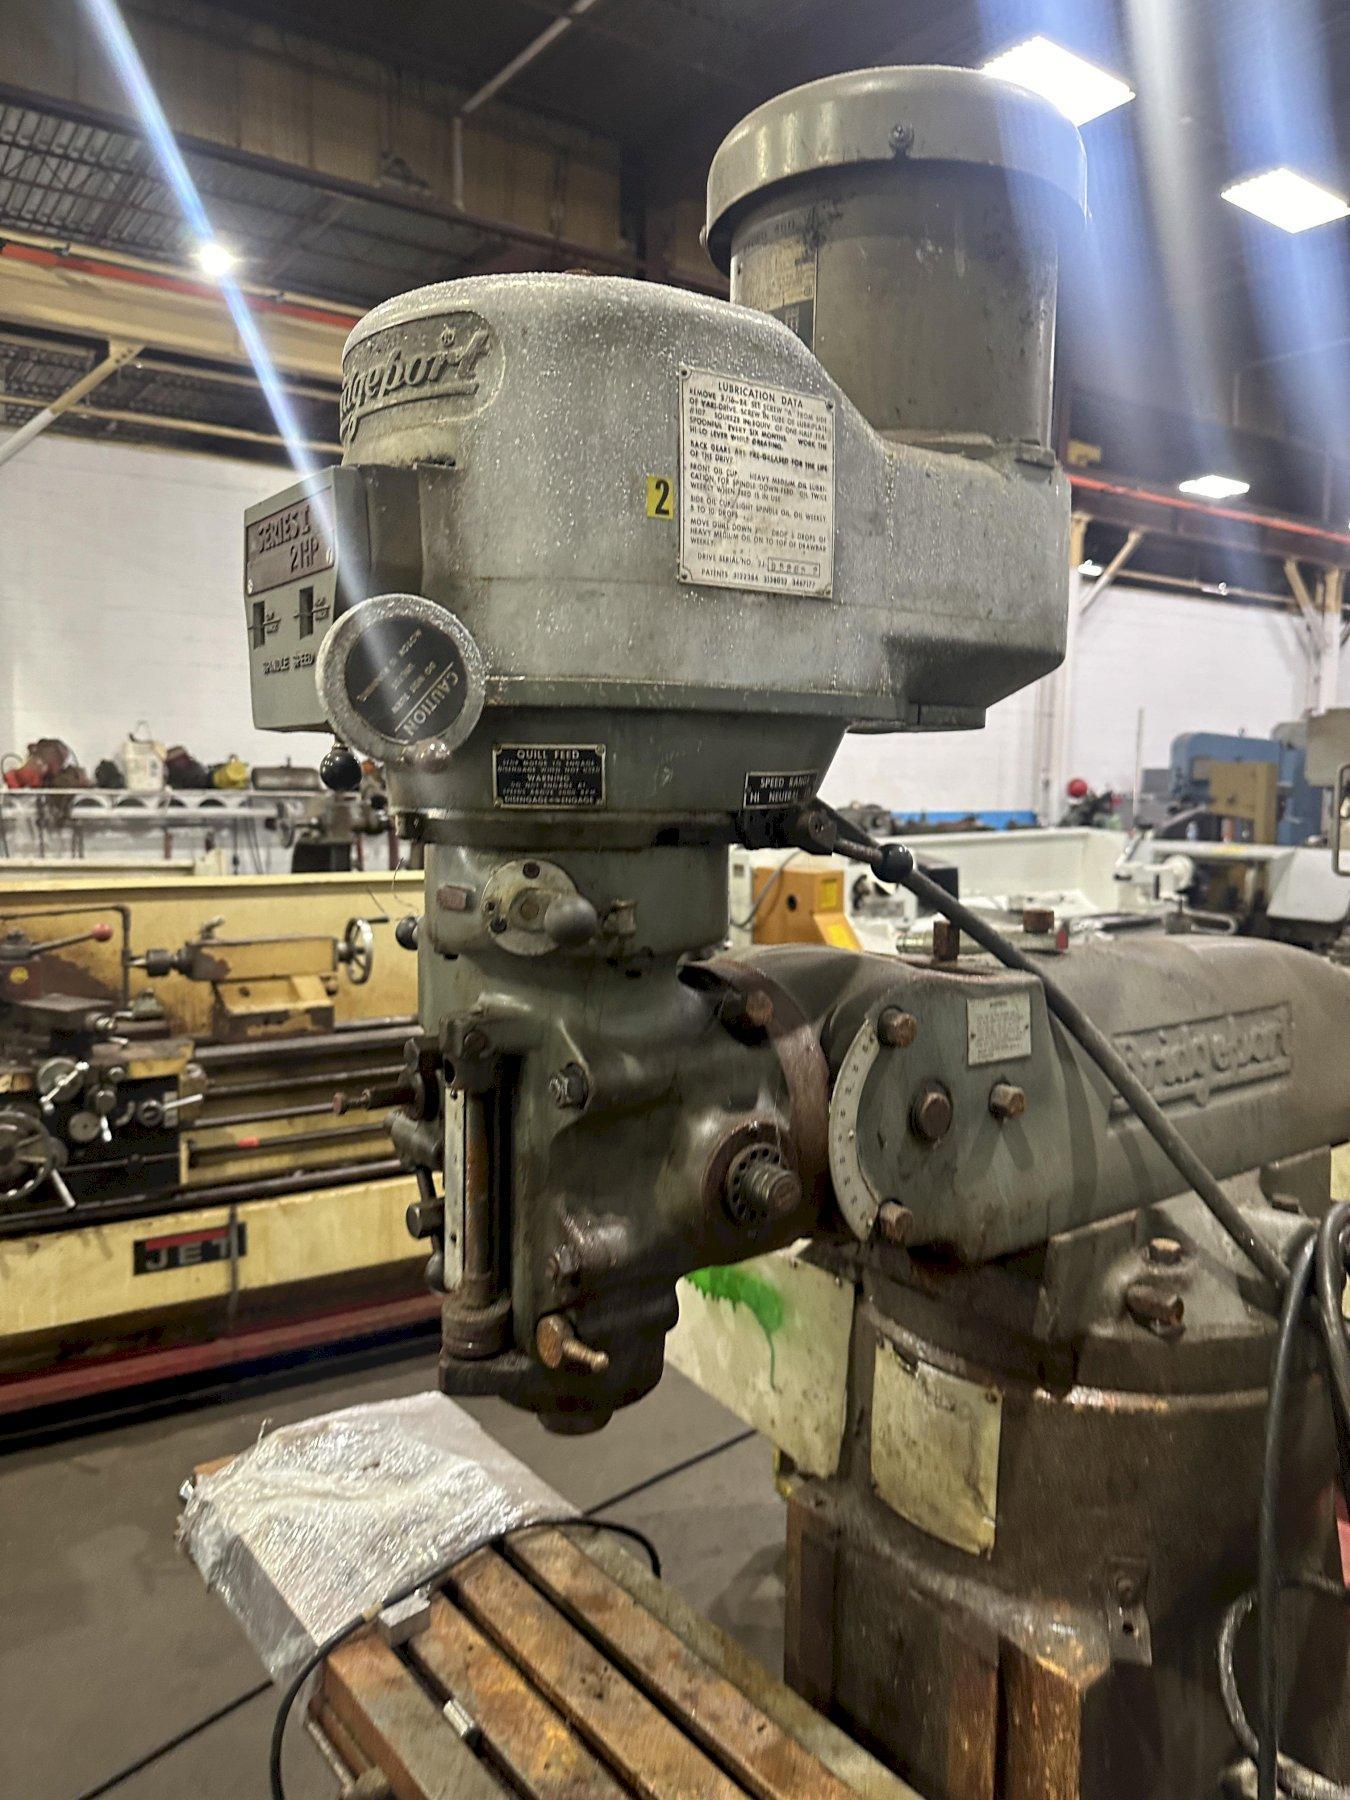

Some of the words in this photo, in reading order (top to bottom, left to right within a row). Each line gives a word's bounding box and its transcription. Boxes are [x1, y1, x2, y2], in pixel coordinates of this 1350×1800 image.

[689, 388, 716, 400] REMOVE
[689, 397, 698, 406] OF
[718, 381, 775, 403] LUBRICATION
[781, 395, 803, 408] DATA
[710, 430, 728, 440] LEVER
[727, 423, 747, 433] EVERY
[749, 428, 759, 436] SIX
[797, 438, 816, 449] WORK
[817, 442, 827, 451] THE
[689, 449, 698, 458] OF
[701, 452, 712, 461] THE
[690, 439, 708, 450] BACK
[710, 443, 731, 454] GEARS
[791, 457, 803, 467] FOR
[804, 460, 815, 469] THE
[690, 462, 710, 472] FRONT
[713, 466, 723, 475] OIL
[749, 471, 769, 482] HEAVY
[771, 475, 796, 487] MEDIUM
[797, 481, 807, 490] OIL
[690, 481, 714, 491] WEEKLY
[716, 485, 735, 495] WHEN
[717, 475, 729, 484] FOR
[799, 490, 809, 499] OIL
[655, 479, 670, 516] 2
[690, 494, 704, 503] SIDE
[706, 497, 716, 505] OIL
[793, 511, 803, 519] OIL
[697, 505, 706, 513] TO
[708, 507, 715, 515] 10
[257, 511, 301, 554] SERIES
[690, 517, 709, 527] MOVE
[732, 523, 752, 533] DOWN
[690, 527, 711, 537] HEAVY
[713, 530, 739, 540] MEDIUM
[741, 533, 751, 543] OIL
[753, 535, 764, 544] ON
[766, 537, 774, 545] TO
[697, 552, 716, 562] DRIVE
[719, 555, 739, 565] SERIAL
[701, 568, 729, 578] PATENTS
[403, 671, 460, 737] CAUTION
[516, 749, 547, 760] QUILL
[554, 749, 580, 760] FEED
[527, 774, 570, 782] WARNING
[760, 776, 785, 789] SPEED
[750, 791, 760, 803] HI
[145, 1238, 231, 1270] JET
